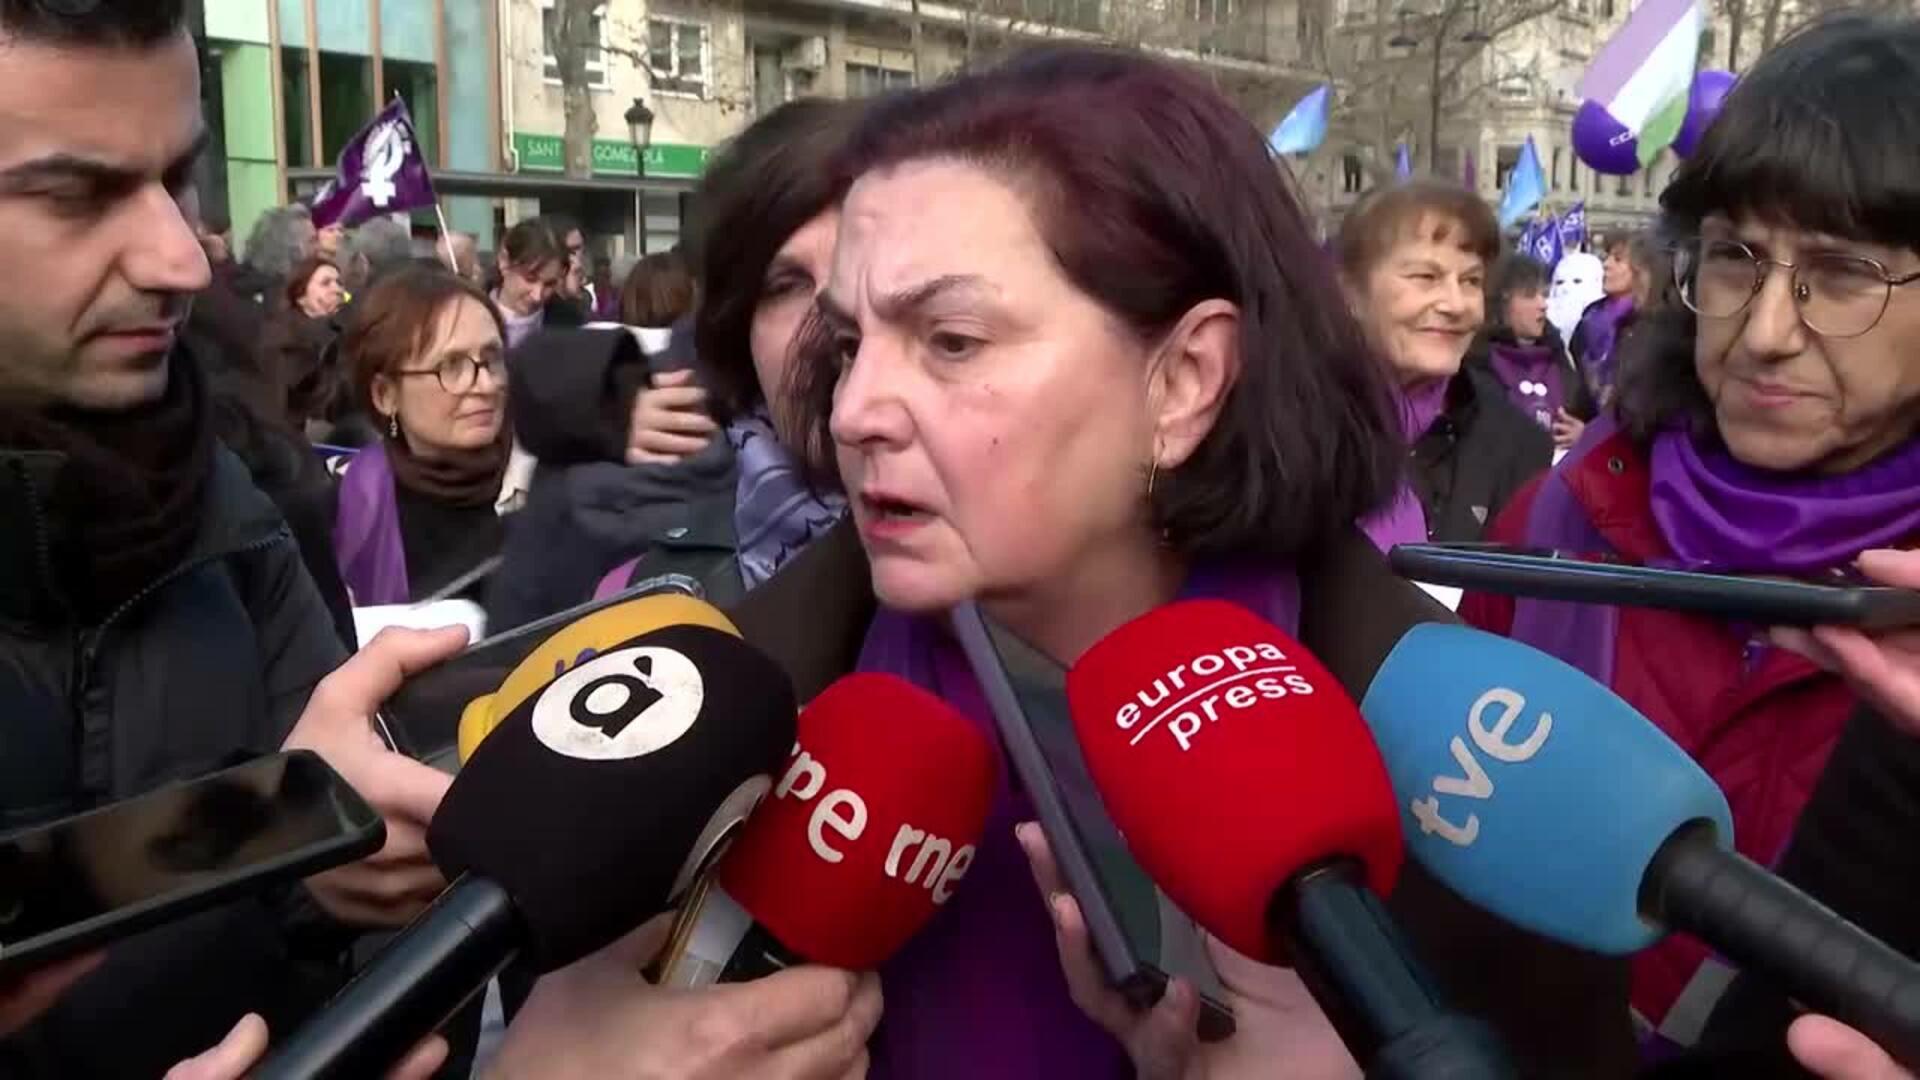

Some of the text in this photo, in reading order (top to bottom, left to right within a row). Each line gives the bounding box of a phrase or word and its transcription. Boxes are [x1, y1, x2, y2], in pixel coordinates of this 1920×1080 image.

[527, 139, 562, 157] SANT
[1115, 643, 1288, 729] europa
[1167, 674, 1315, 752] press
[775, 741, 869, 864] pe
[1410, 686, 1553, 847] tve
[884, 823, 977, 905] rne
